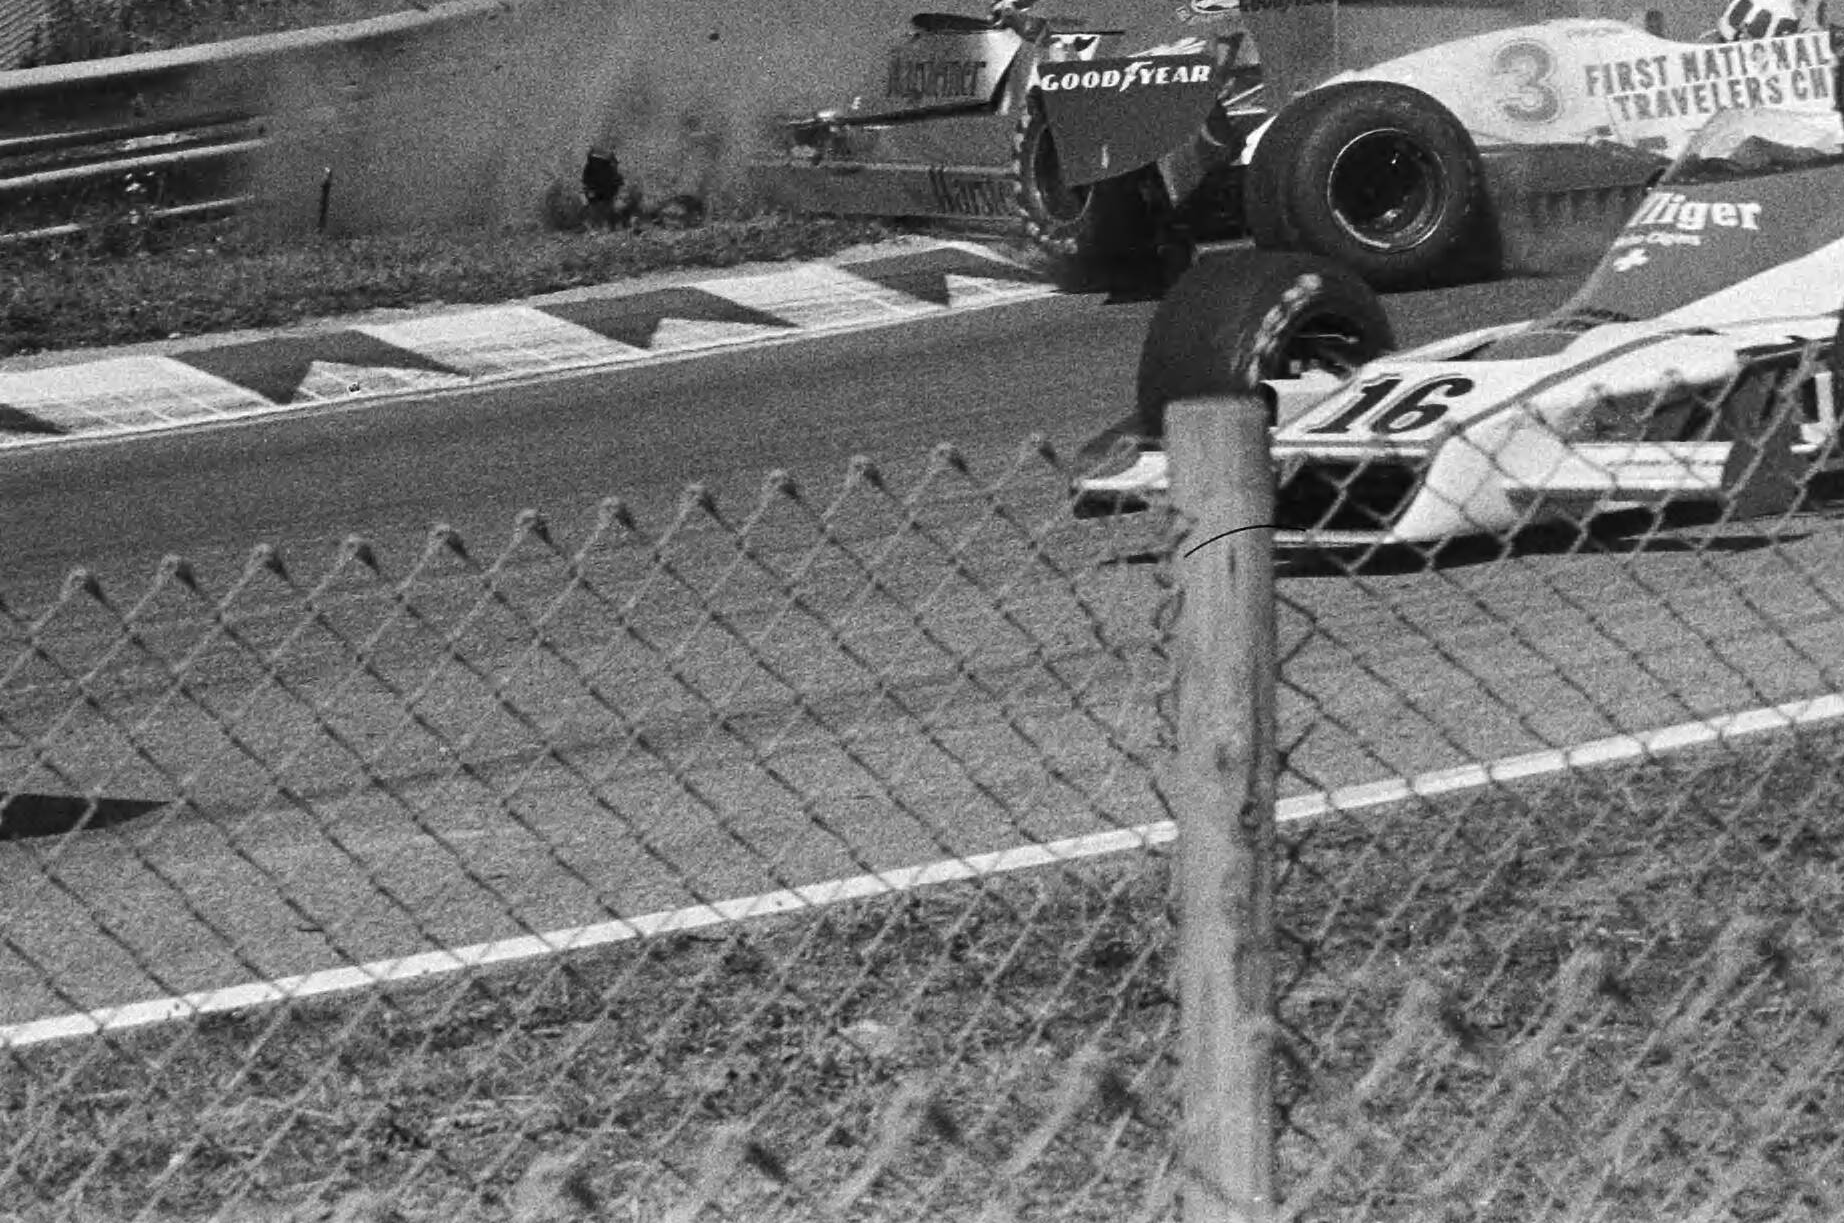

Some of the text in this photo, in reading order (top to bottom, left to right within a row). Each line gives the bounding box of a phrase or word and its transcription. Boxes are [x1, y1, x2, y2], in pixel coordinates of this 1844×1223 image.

[1496, 41, 1562, 125] 3
[1585, 35, 1830, 96] FIRST NATIONAL
[1613, 75, 1784, 122] TRAVELERS
[1307, 374, 1475, 433] 16
